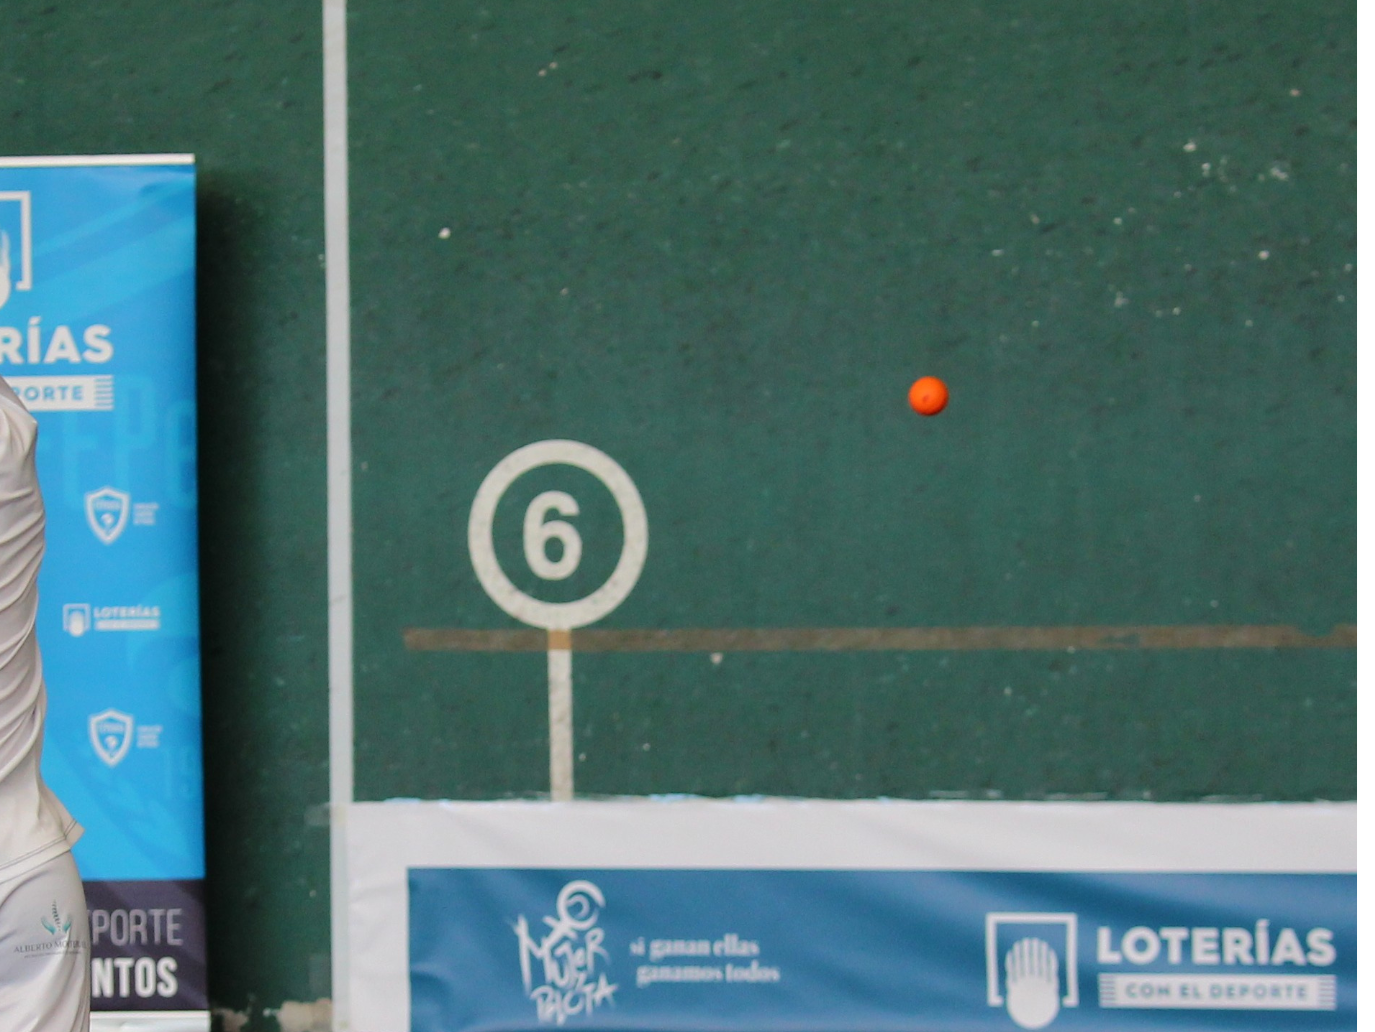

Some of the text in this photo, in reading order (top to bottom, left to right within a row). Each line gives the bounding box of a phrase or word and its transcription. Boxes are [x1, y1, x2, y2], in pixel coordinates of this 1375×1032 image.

[523, 490, 582, 580] 6
[87, 908, 184, 946] PORTE
[1097, 918, 1337, 966] LOTERÍAS
[13, 942, 52, 953] ALBERTO
[649, 939, 711, 962] ganan
[713, 933, 761, 956] ellas
[636, 959, 781, 989] ganamos todos
[1179, 982, 1201, 999] EL
[1209, 982, 1308, 1000] DEPORTE
